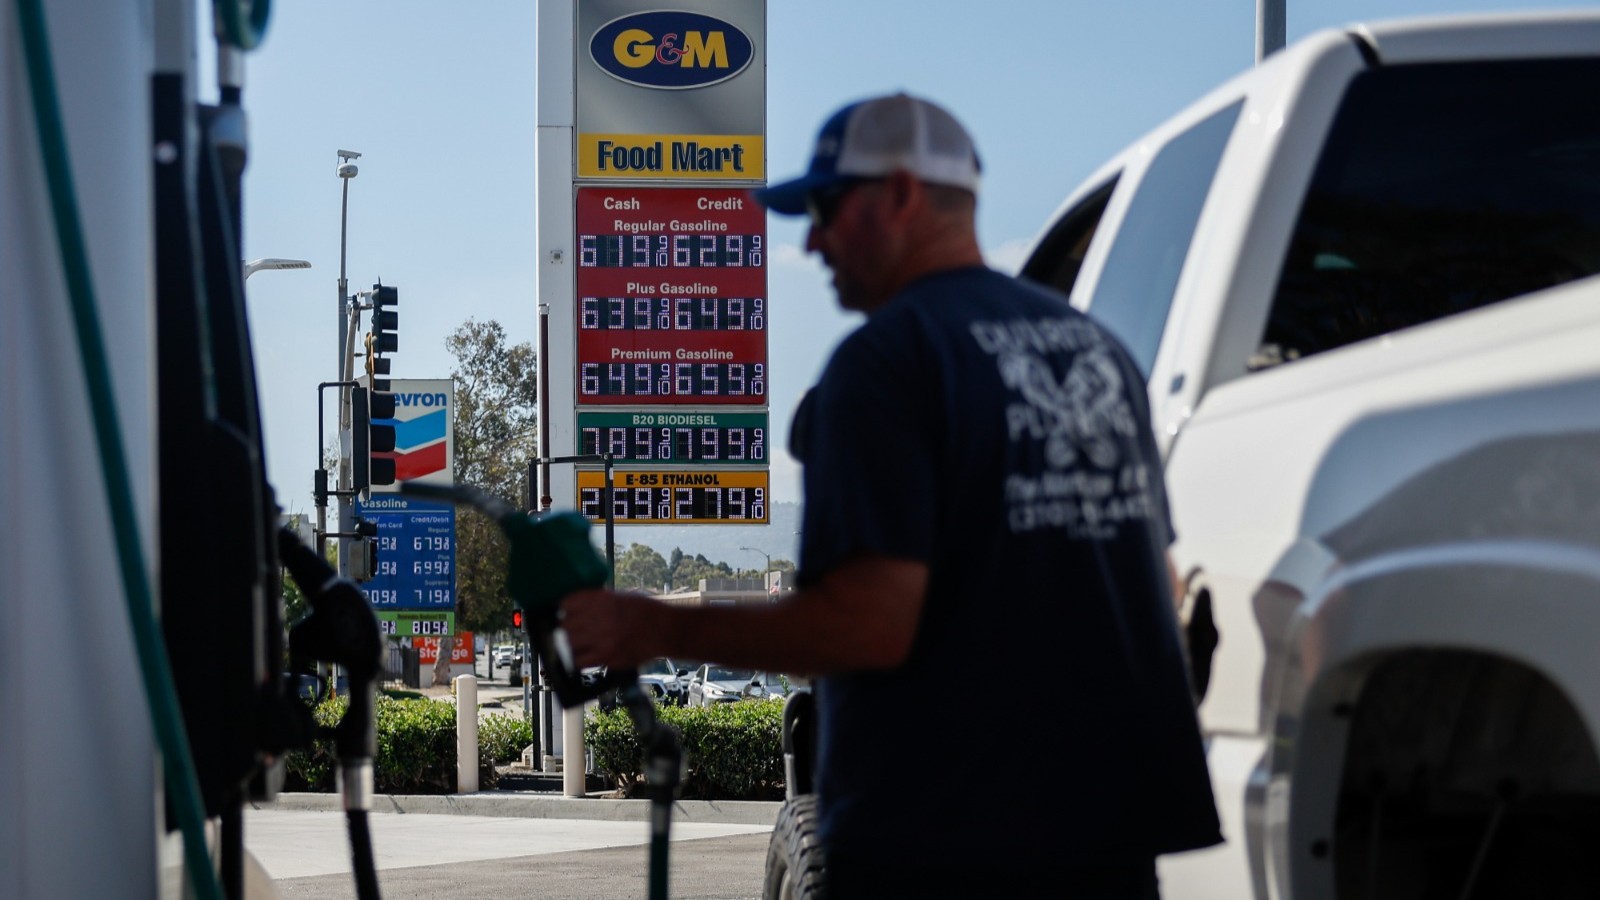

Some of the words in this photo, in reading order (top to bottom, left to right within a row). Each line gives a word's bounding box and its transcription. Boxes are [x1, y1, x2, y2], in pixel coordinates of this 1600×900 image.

[613, 28, 729, 69] G&M
[597, 140, 663, 171] Food
[671, 141, 744, 172] Mart
[604, 197, 640, 210] Cash
[697, 197, 743, 210] Credit
[614, 220, 665, 234] Regular
[669, 220, 728, 231] Gasoline
[626, 282, 656, 294] Plus
[659, 282, 718, 294] Gasoline
[611, 348, 671, 360] Premium
[675, 348, 734, 360] Gasoline
[632, 415, 654, 425] B20
[657, 415, 717, 425] BIODIESEL
[625, 473, 658, 485] E-85
[662, 473, 720, 485] ETHANOL
[361, 499, 407, 509] Gasoline
[419, 648, 468, 660] Stoge
